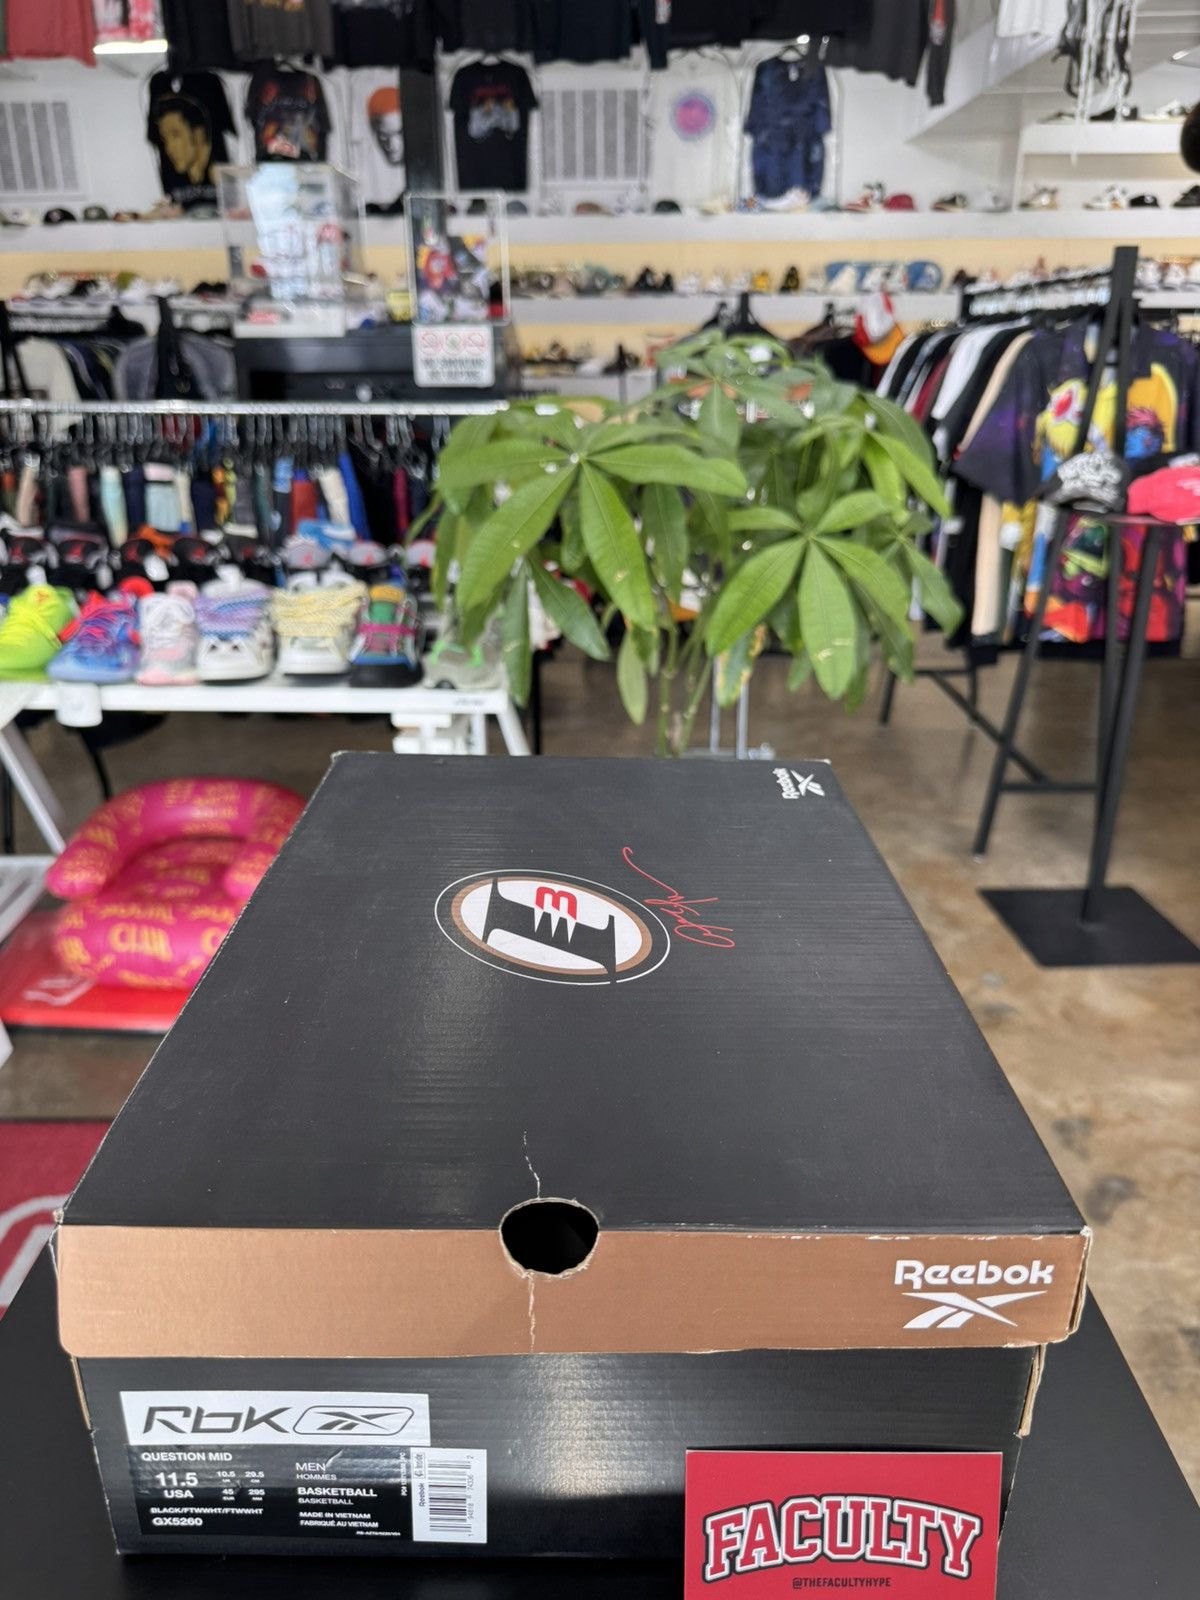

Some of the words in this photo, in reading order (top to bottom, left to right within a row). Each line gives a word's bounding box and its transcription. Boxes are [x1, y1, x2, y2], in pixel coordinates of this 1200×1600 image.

[772, 767, 800, 800] Reebok
[894, 1259, 1055, 1290] Reebok
[141, 1451, 206, 1462] QUESTION
[208, 1452, 233, 1462] MID
[295, 1462, 326, 1472] MEN
[155, 1471, 199, 1487] 11.5
[217, 1470, 236, 1478] 10.5
[245, 1471, 265, 1479] 29.5
[296, 1473, 338, 1481] HOMMES
[163, 1489, 194, 1499] USA
[248, 1488, 266, 1496] 295
[297, 1487, 378, 1497] BASKETBALL
[418, 1482, 426, 1507] Reebok
[298, 1498, 355, 1506] BASKETBALL
[299, 1511, 323, 1519] MADE
[151, 1517, 204, 1527] GX5260
[336, 1520, 348, 1528] AU
[347, 1521, 379, 1529] VIETNAM
[703, 1493, 983, 1583] FACULTY
[792, 1577, 892, 1590] @THEFACULTYHYPE
